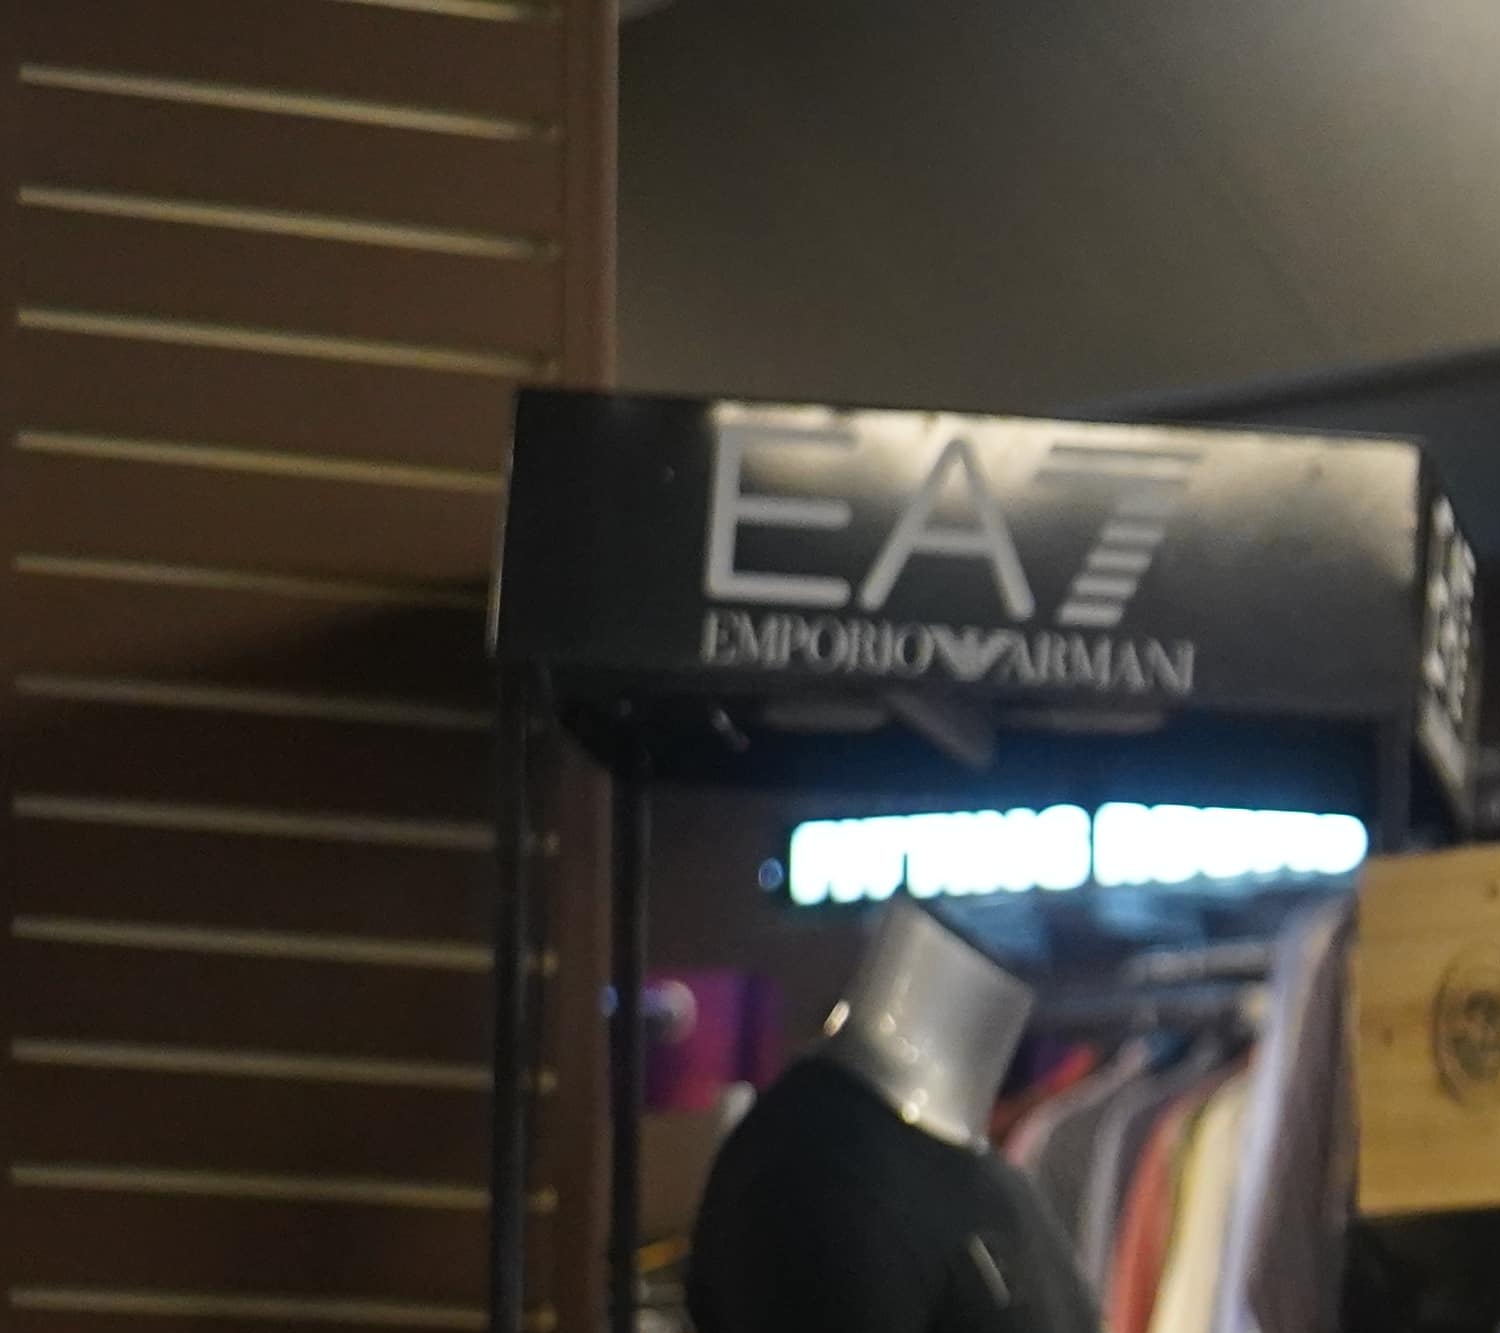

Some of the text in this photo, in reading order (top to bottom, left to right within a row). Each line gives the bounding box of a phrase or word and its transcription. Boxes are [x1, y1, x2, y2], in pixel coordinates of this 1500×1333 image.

[706, 426, 1204, 628] EA7
[702, 610, 1196, 697] EMPORIO ARMANI
